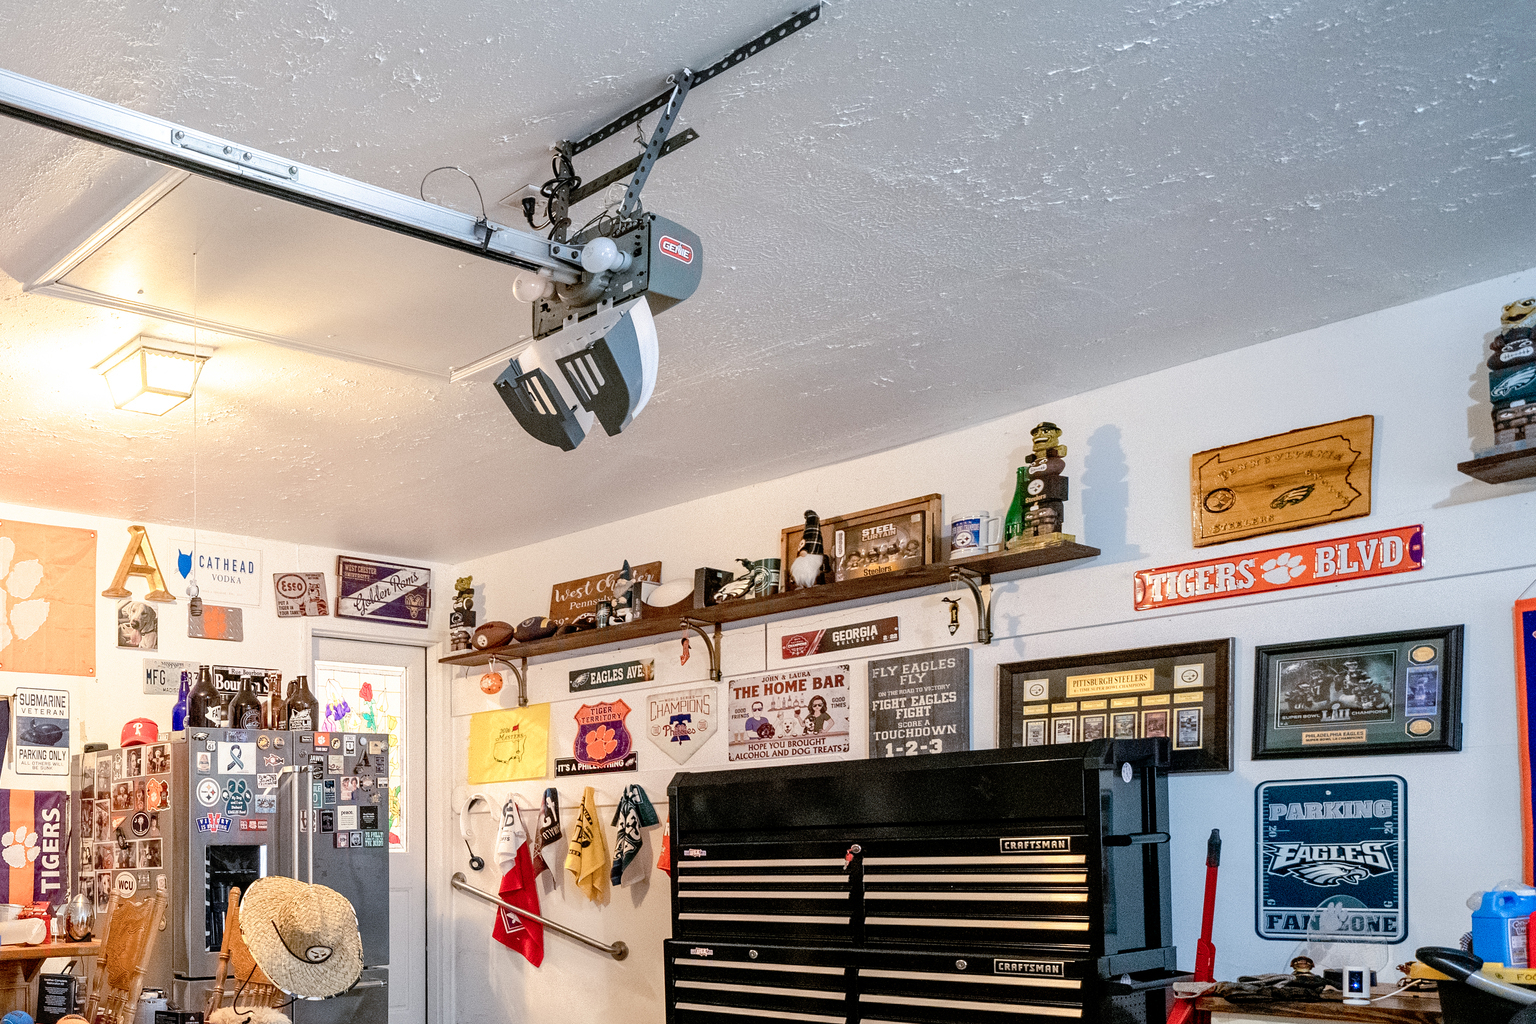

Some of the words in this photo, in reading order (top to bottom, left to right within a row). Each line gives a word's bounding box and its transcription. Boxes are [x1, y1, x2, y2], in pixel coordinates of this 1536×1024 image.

[662, 239, 691, 259] GENIE
[1217, 450, 1346, 482] PENNSYLVANIA
[862, 524, 896, 537] STEEL
[1213, 514, 1275, 534] STEELERS
[862, 530, 897, 542] CURTAIN
[101, 525, 177, 602] A
[199, 555, 254, 574] CATHEAD
[863, 565, 892, 576] Steelers
[1148, 557, 1256, 602] TIGERS
[1314, 535, 1404, 579] BLVD
[211, 573, 242, 585] VODKA
[555, 580, 593, 602] West
[596, 569, 654, 592] Chter
[832, 625, 878, 643] GEORGIA
[836, 635, 875, 646] BULLDOGS
[872, 666, 898, 679] FLY
[902, 658, 956, 675] EAGLES
[146, 669, 166, 685] MFG
[590, 668, 623, 685] EAGLES
[762, 674, 779, 683] JOHN
[789, 671, 811, 680] LAURA
[900, 673, 926, 685] FLY
[1072, 676, 1113, 688] PITTSBURGH
[1114, 674, 1148, 683] STEELERS
[733, 685, 760, 700] THE
[764, 679, 808, 696] HOME
[813, 674, 845, 690] BAR
[924, 683, 951, 692] VICTORY
[19, 693, 66, 708] SUBMARINE
[872, 697, 907, 711] FIGHT
[911, 691, 957, 707] EAGLES
[21, 707, 64, 716] VETERAN
[590, 706, 612, 716] TIGER
[650, 695, 710, 722] CHAMPIONS
[896, 706, 931, 719] FIGHT
[581, 712, 622, 724] TERRITORY
[897, 720, 922, 728] SCORE
[873, 724, 957, 741] TOUCHDOWN
[748, 743, 767, 752] HOPE
[769, 741, 786, 750] YOU
[788, 738, 826, 748] BROUGHT
[885, 739, 943, 758] 1-2-3
[19, 749, 47, 760] PARKING
[48, 750, 66, 761] ONLY
[735, 750, 769, 761] ALCOHOL
[771, 749, 789, 757] AND
[791, 747, 810, 756] DOG
[813, 745, 843, 754] TREATS
[1269, 799, 1393, 821] PARKING
[41, 806, 61, 894] TIGERS
[1004, 839, 1066, 850] CRAFTSMAN
[1270, 842, 1393, 871] EAGLES
[118, 880, 134, 891] WCU
[998, 962, 1059, 974] CRAFTSMAN
